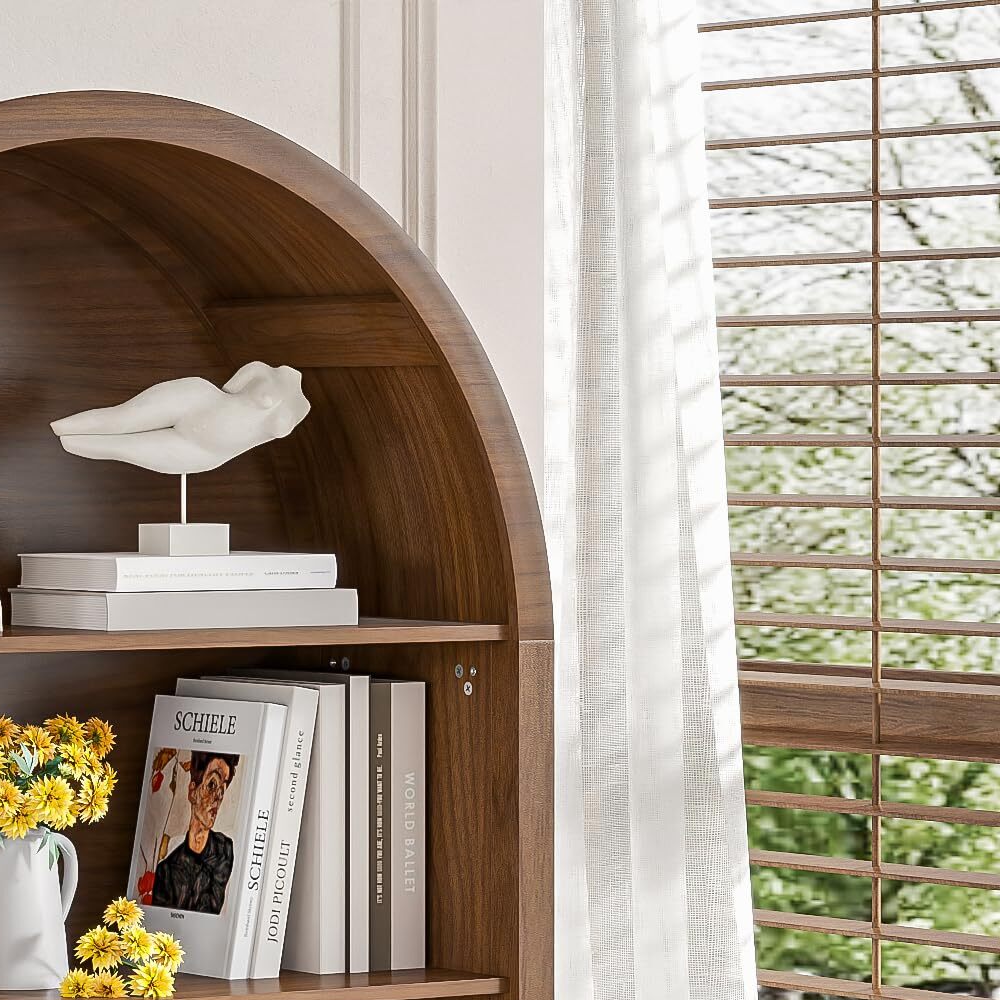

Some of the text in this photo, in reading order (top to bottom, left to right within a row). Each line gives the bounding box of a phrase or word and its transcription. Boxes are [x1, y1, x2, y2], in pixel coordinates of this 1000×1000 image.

[174, 711, 237, 735] SCHIELE
[288, 730, 304, 812] second glance
[248, 809, 270, 891] SCHIELE
[403, 772, 416, 894] WORLD BALLET
[267, 840, 291, 943] JODI PICOULT
